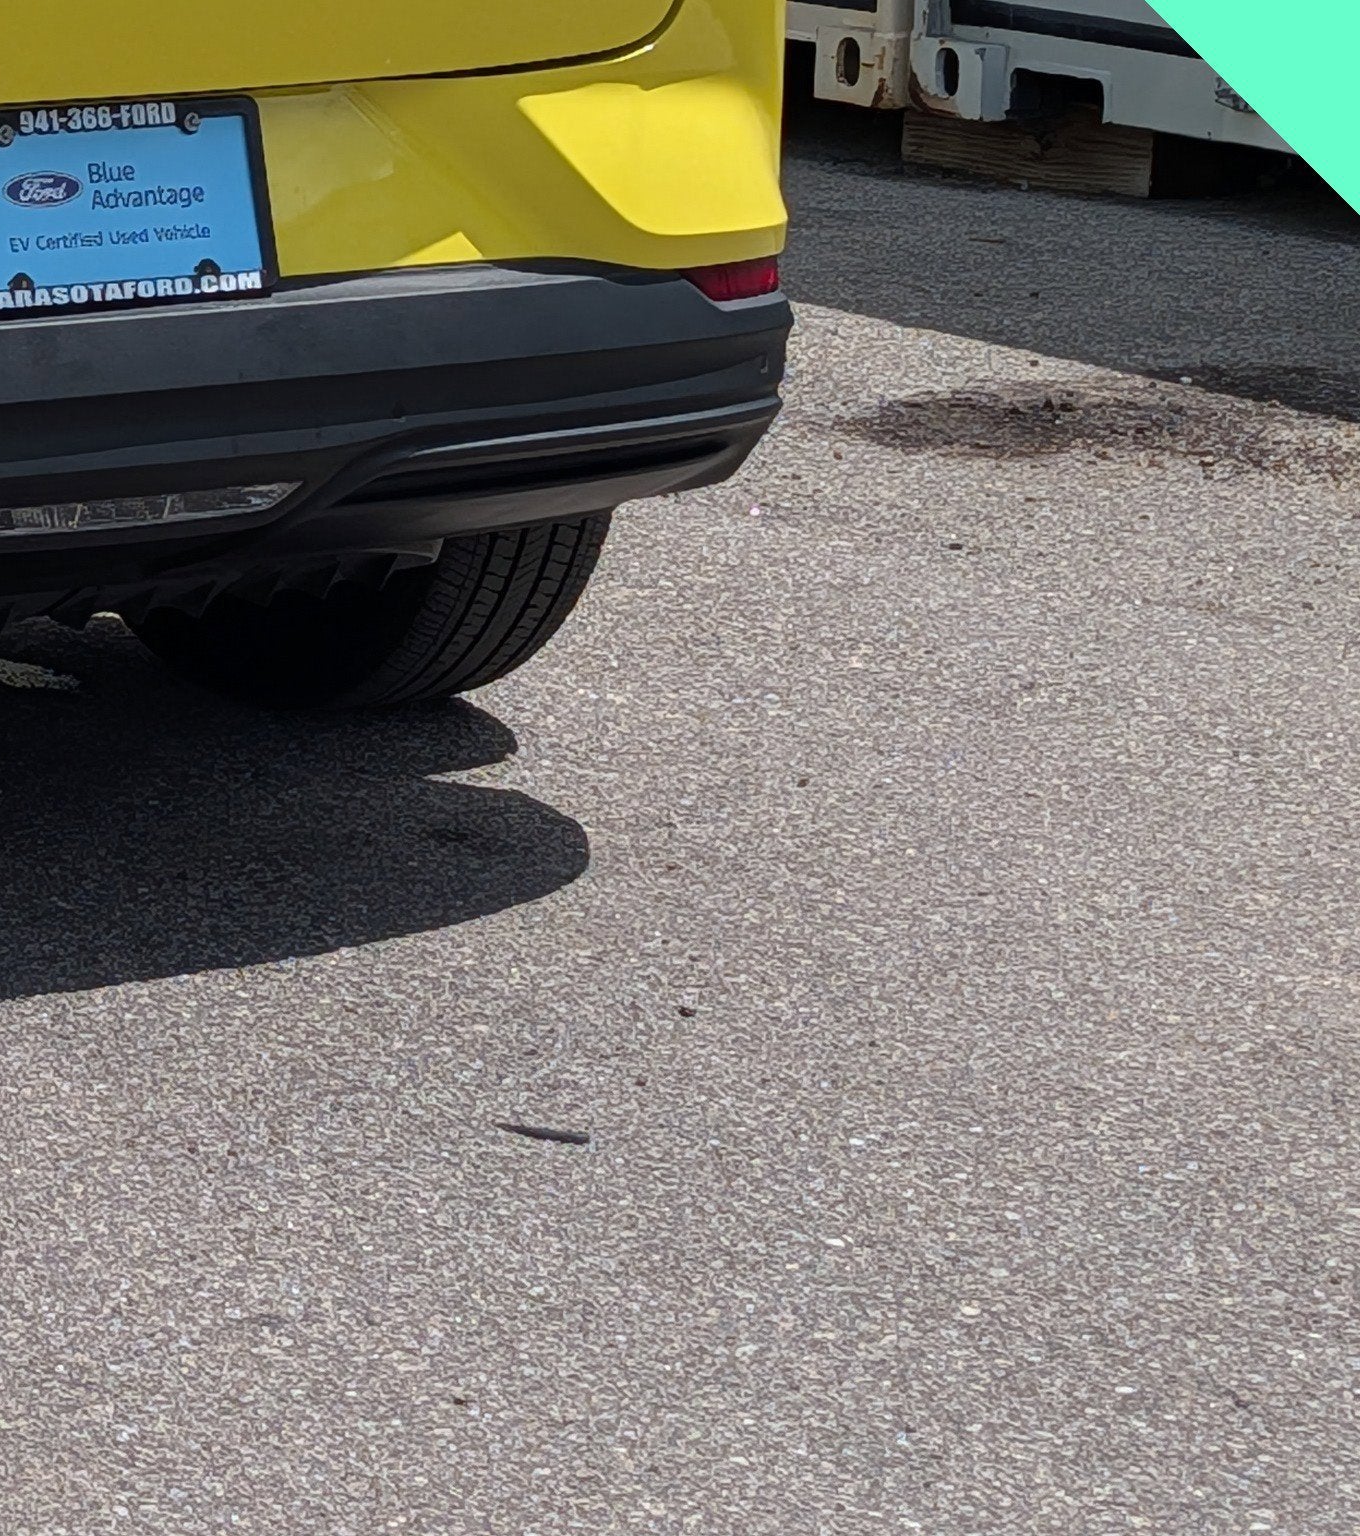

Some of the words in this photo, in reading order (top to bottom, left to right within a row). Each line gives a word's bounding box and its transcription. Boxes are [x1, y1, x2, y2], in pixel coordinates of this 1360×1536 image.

[87, 161, 136, 184] Blue
[18, 177, 68, 202] Ford
[91, 185, 206, 210] Advantage
[9, 237, 30, 253] EV
[109, 227, 150, 246] Used
